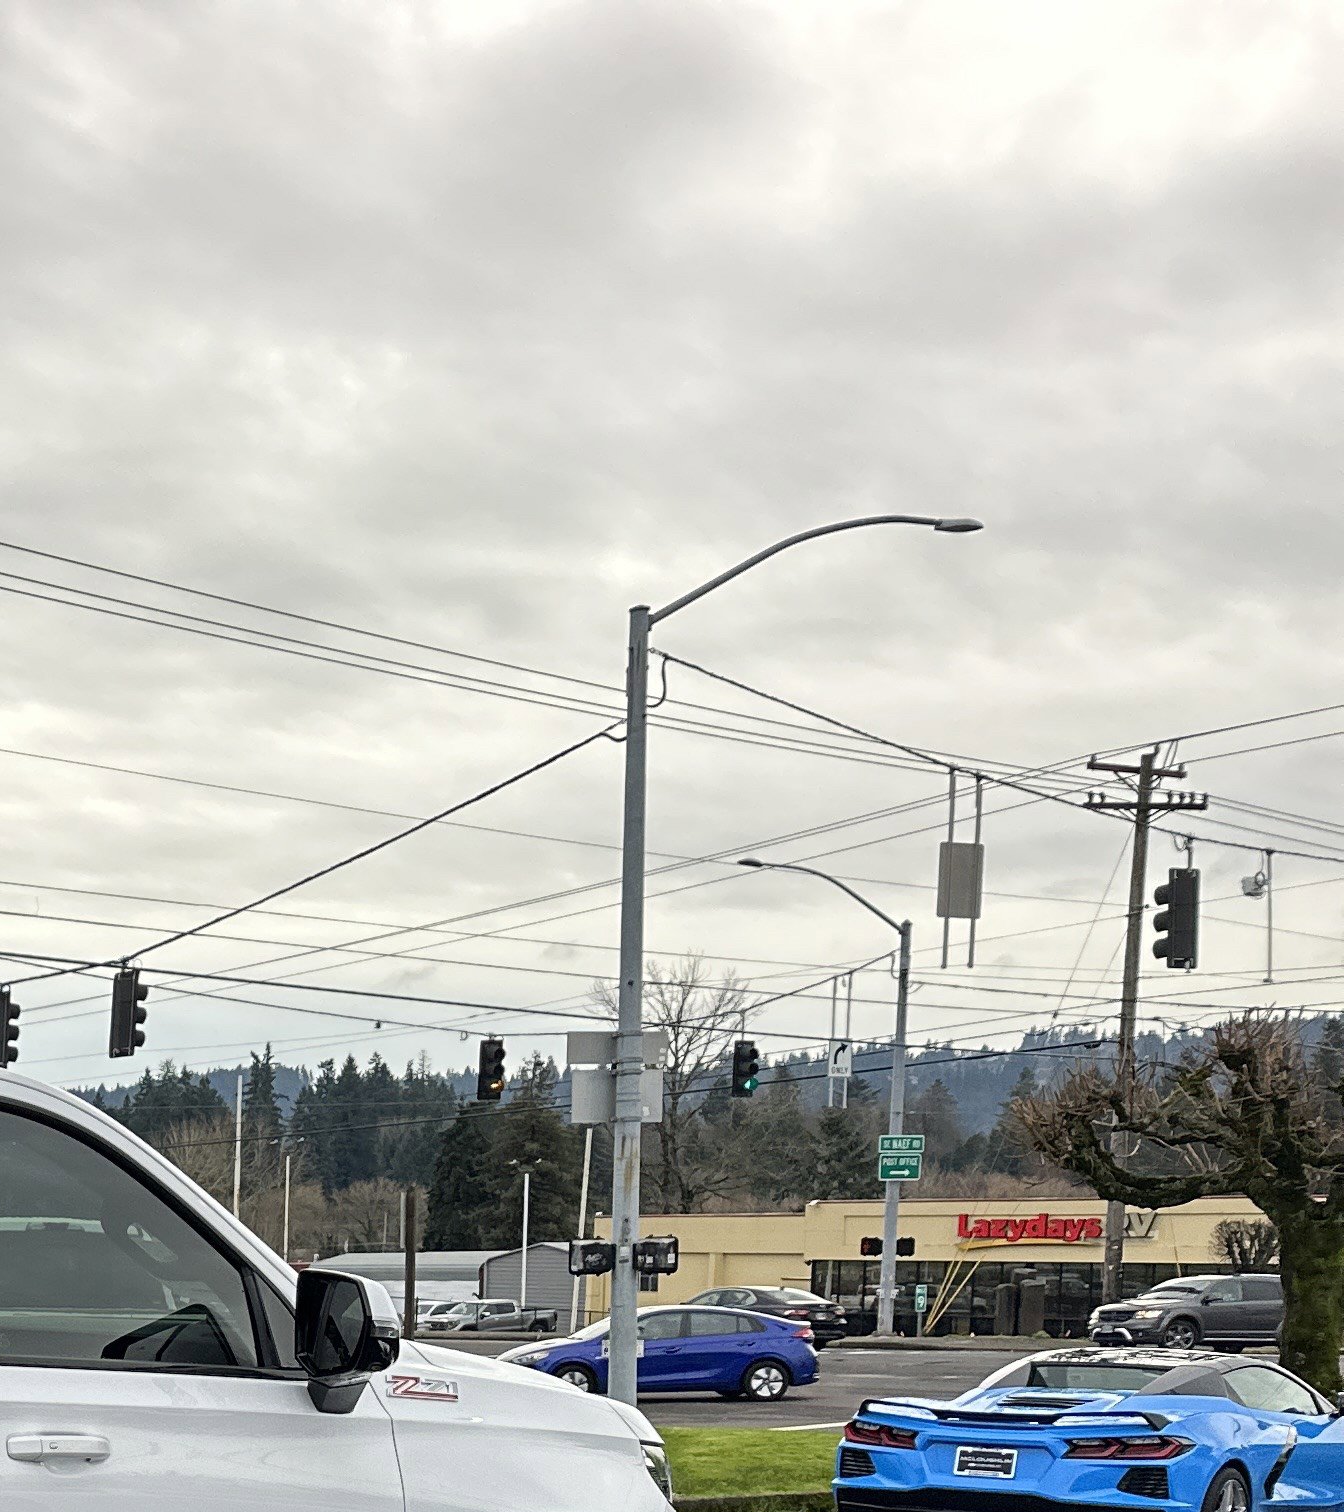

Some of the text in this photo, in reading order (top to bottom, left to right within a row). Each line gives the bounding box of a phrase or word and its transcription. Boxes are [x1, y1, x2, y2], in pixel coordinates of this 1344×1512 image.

[831, 1066, 849, 1075] ONLY
[957, 1213, 1103, 1242] Lazydays
[385, 1374, 459, 1402] Z71
